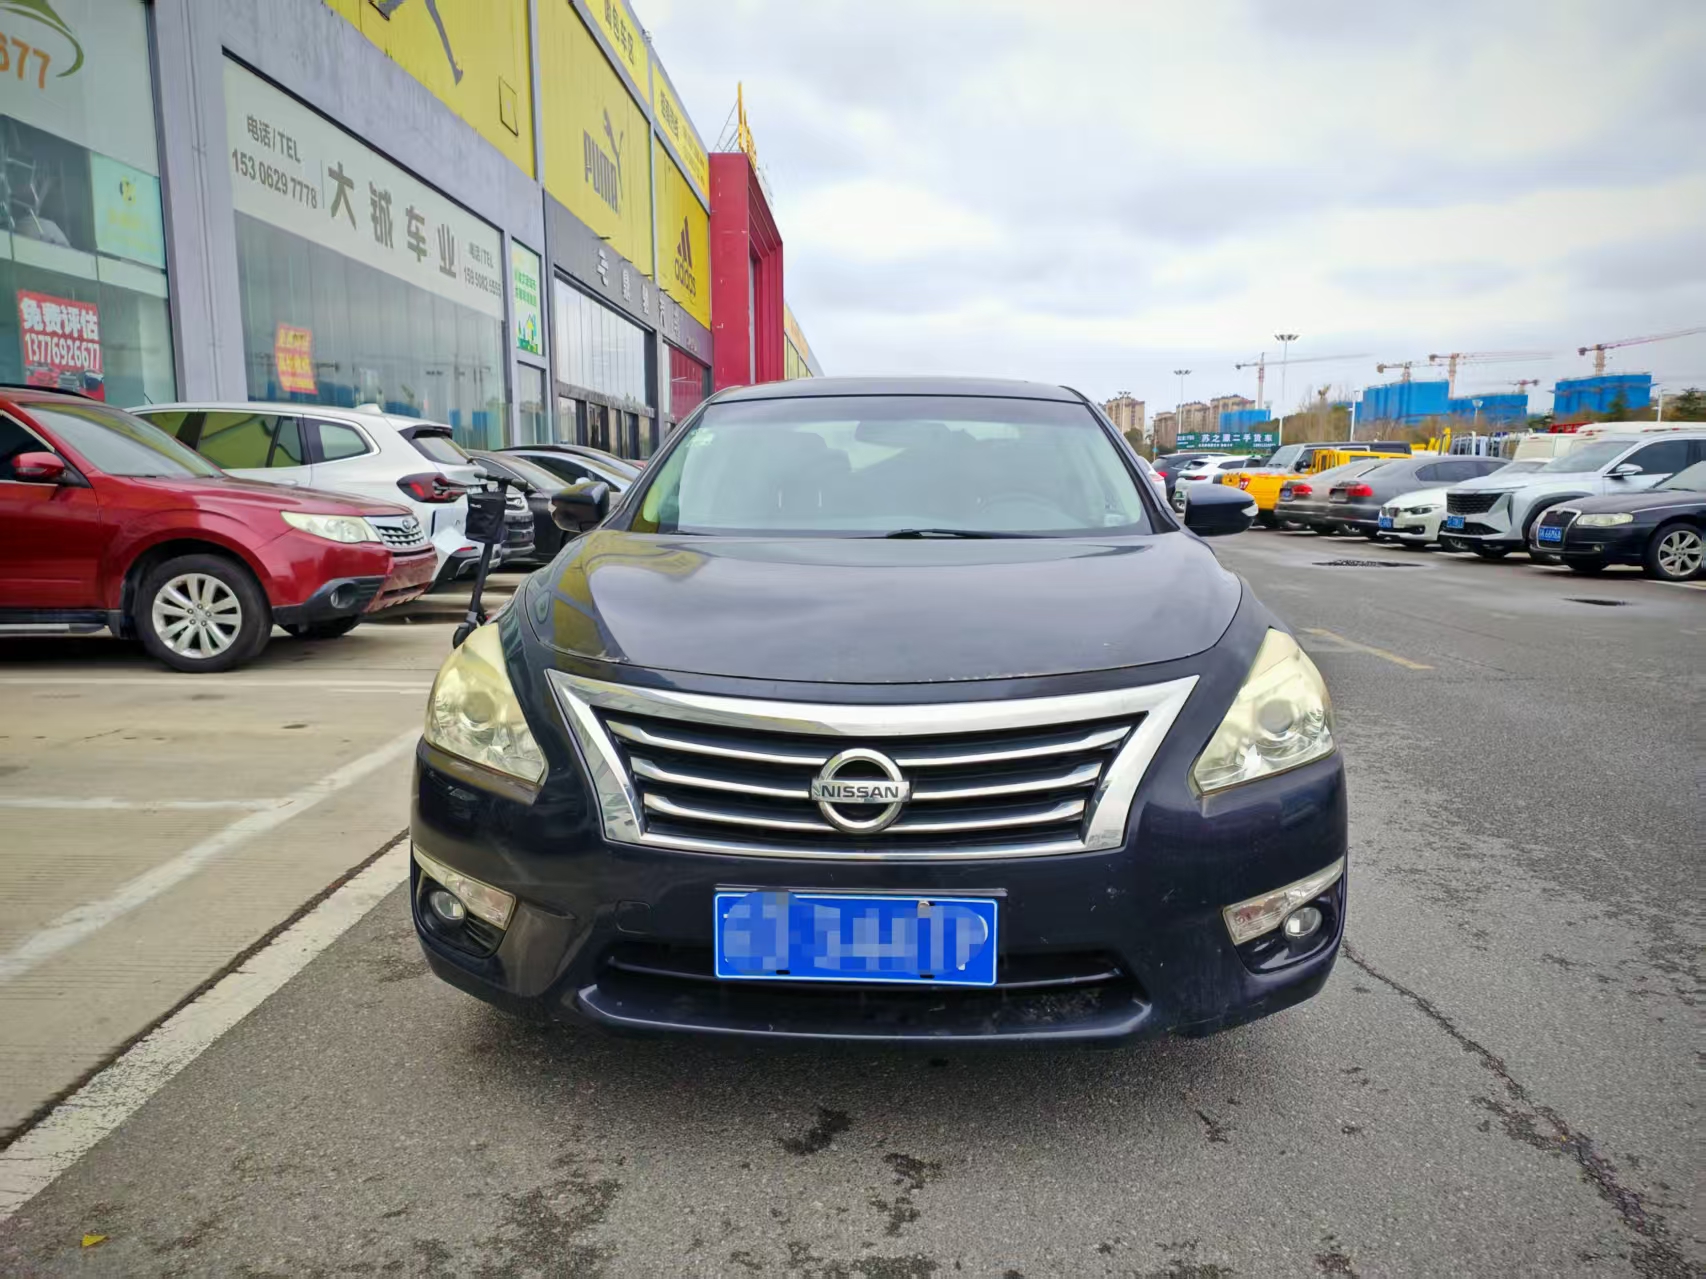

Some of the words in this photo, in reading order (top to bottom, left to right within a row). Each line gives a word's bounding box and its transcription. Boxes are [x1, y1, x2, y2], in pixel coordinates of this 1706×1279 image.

[232, 148, 256, 180] 153
[259, 161, 288, 194] 0629
[290, 176, 317, 209] 7778
[583, 128, 618, 215] PUMA
[20, 297, 99, 340] 免费评估
[25, 333, 101, 370] 13776926677
[821, 784, 899, 799] NISSAN
